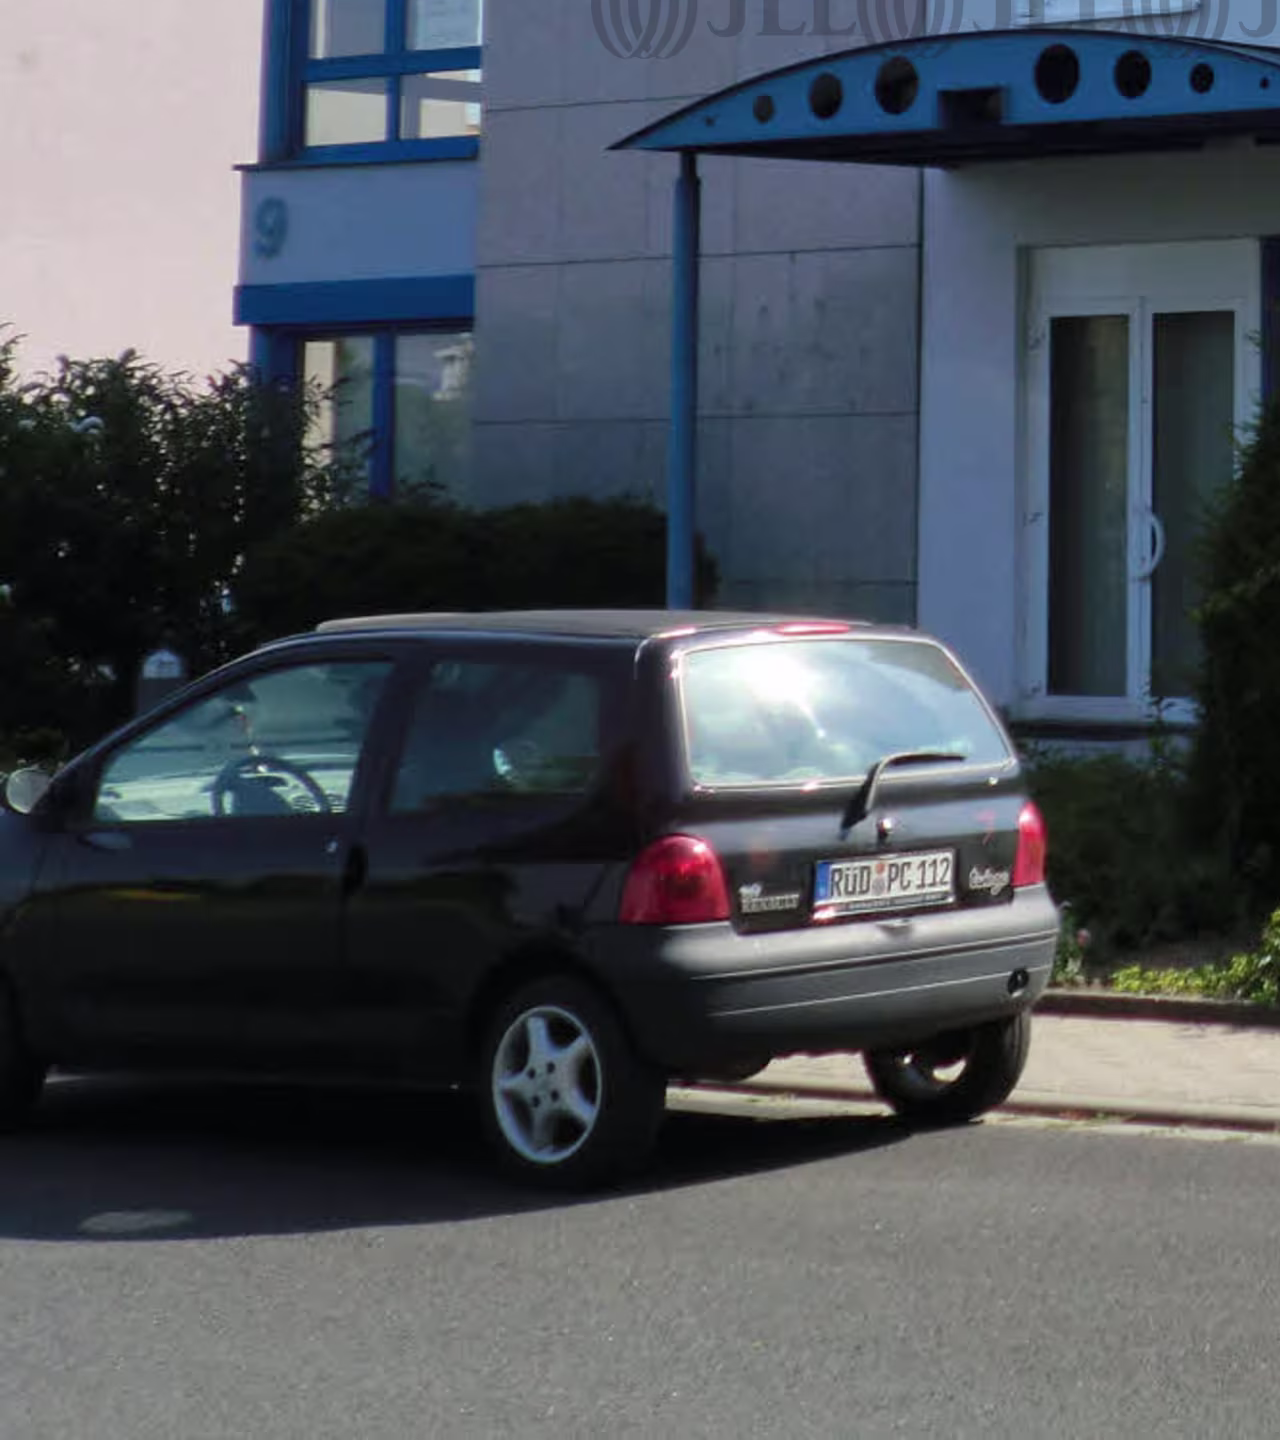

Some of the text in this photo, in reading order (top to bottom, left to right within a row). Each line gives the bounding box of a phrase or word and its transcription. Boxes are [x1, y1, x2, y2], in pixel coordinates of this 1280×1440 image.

[254, 195, 288, 260] 9
[886, 861, 911, 895] PC
[916, 856, 951, 889] 112
